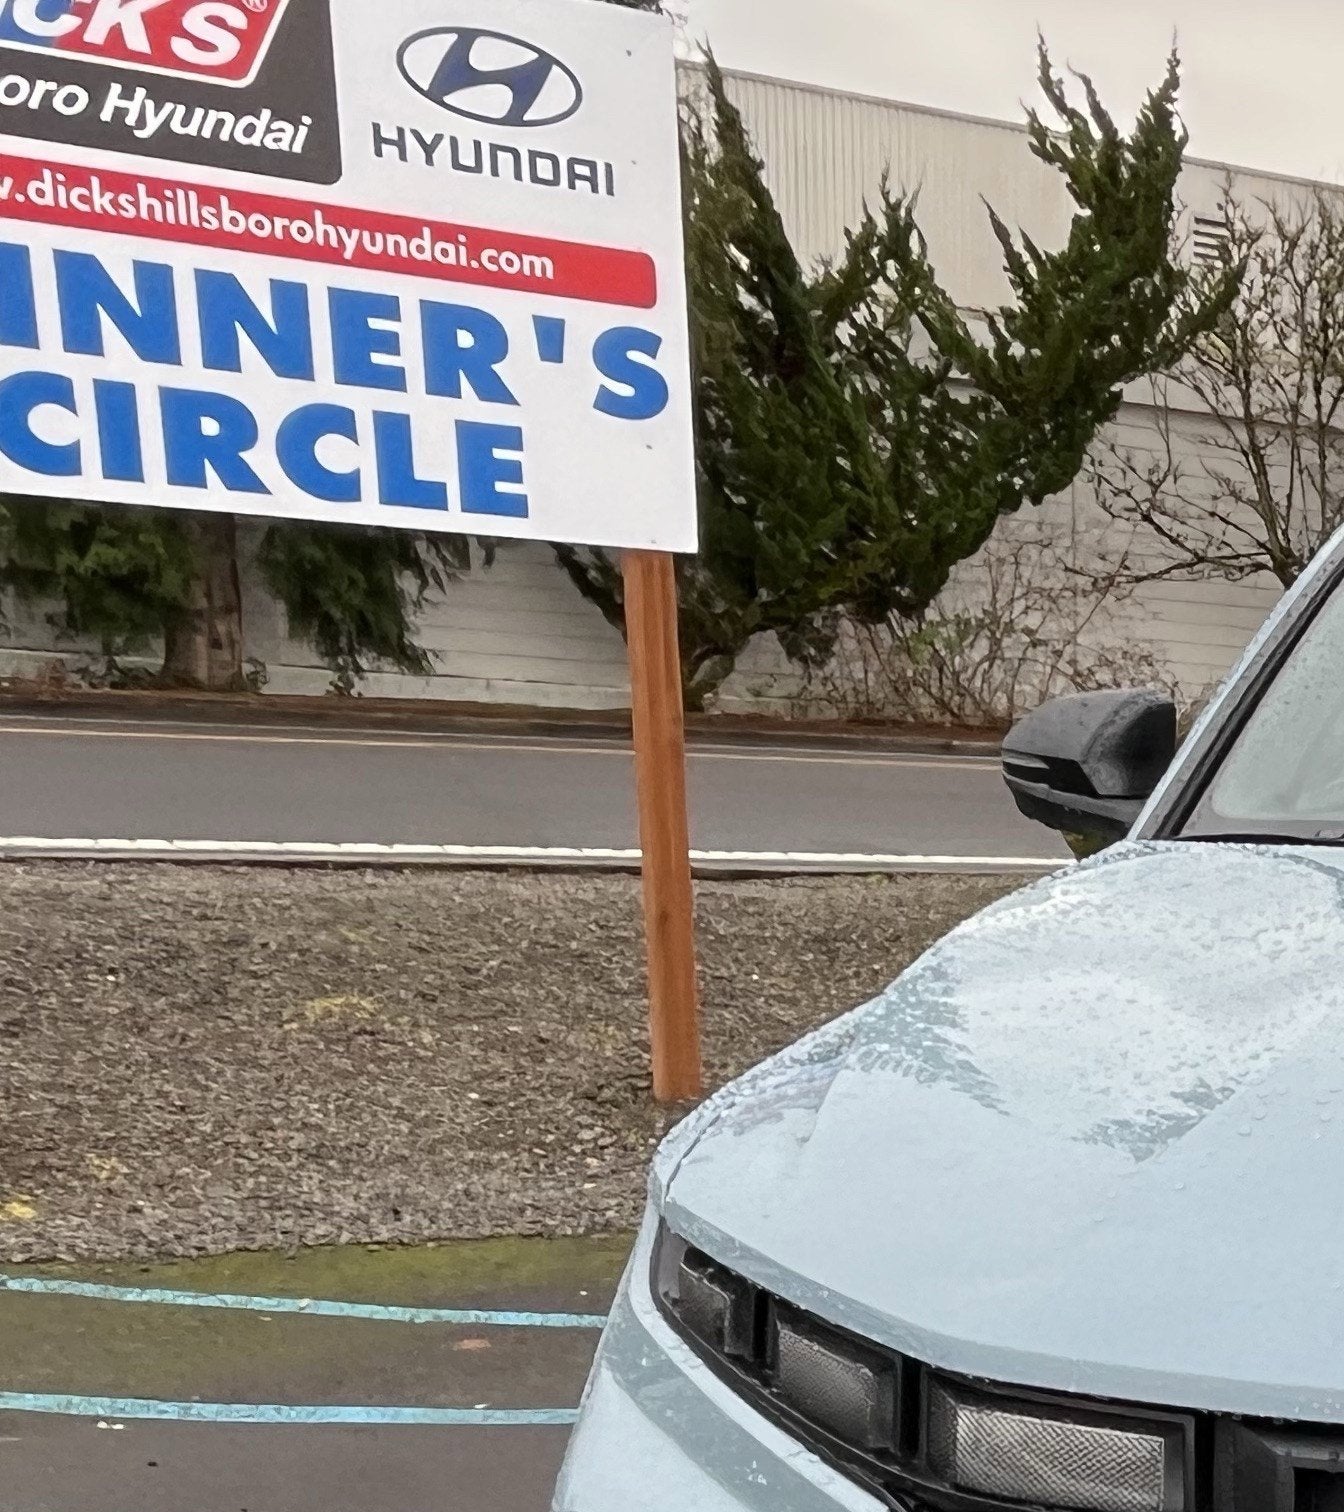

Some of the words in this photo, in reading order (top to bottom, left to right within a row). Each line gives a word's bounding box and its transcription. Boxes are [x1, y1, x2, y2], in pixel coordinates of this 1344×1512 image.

[100, 82, 312, 154] Hyundai
[372, 122, 616, 197] HYUNDAI
[0, 370, 529, 519] CIRCLE
